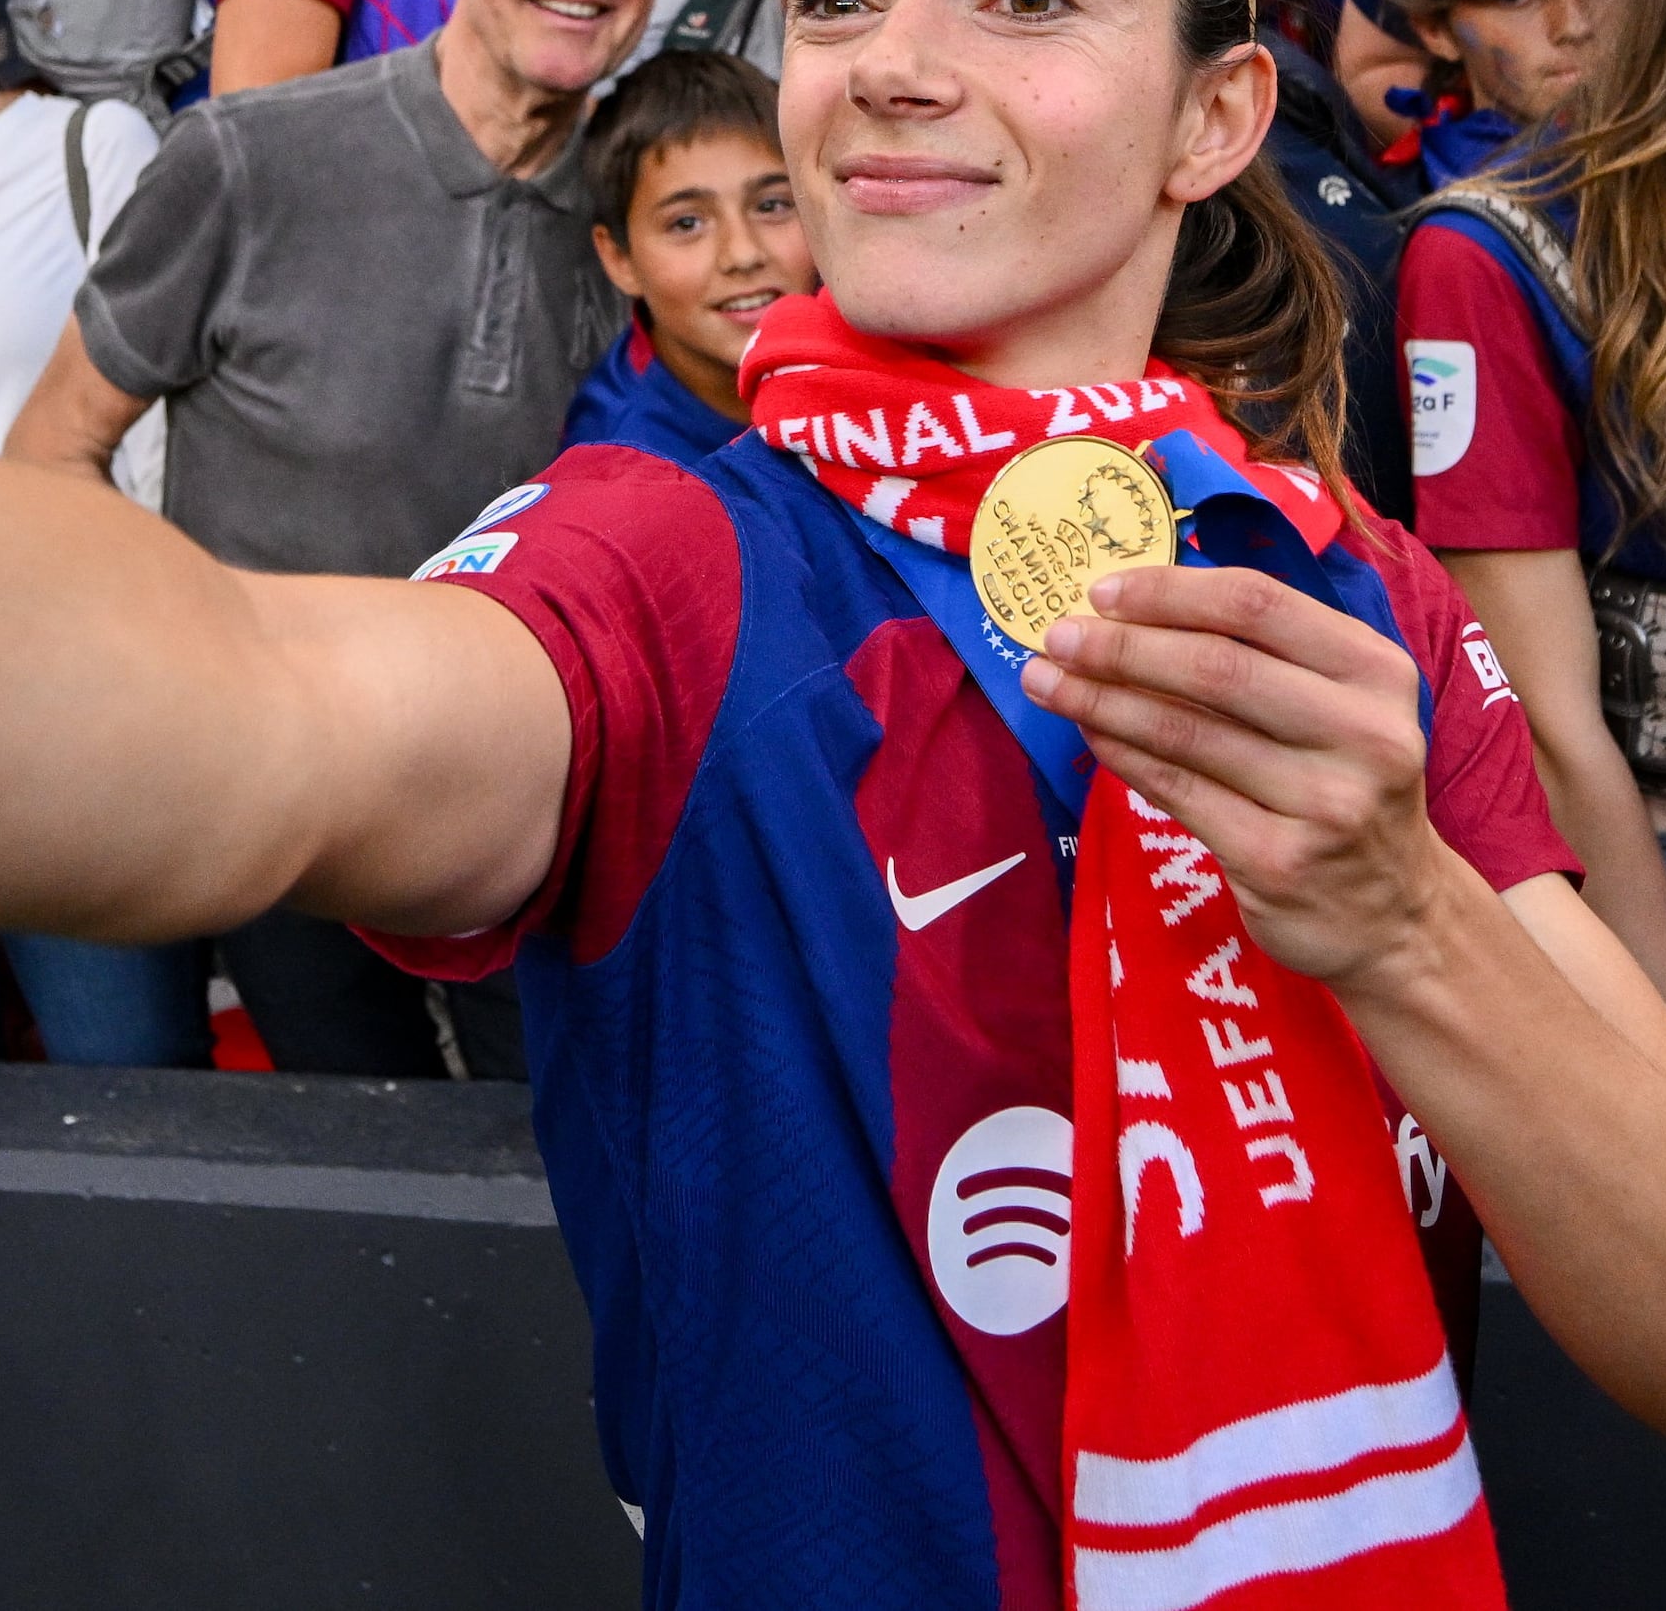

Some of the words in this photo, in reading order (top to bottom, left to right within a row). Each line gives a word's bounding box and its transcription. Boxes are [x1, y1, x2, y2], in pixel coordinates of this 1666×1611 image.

[779, 394, 1015, 468] FINAL
[987, 538, 1050, 633] LEAGUE
[1055, 522, 1086, 568] UEFA
[1186, 935, 1315, 1210] UEFA
